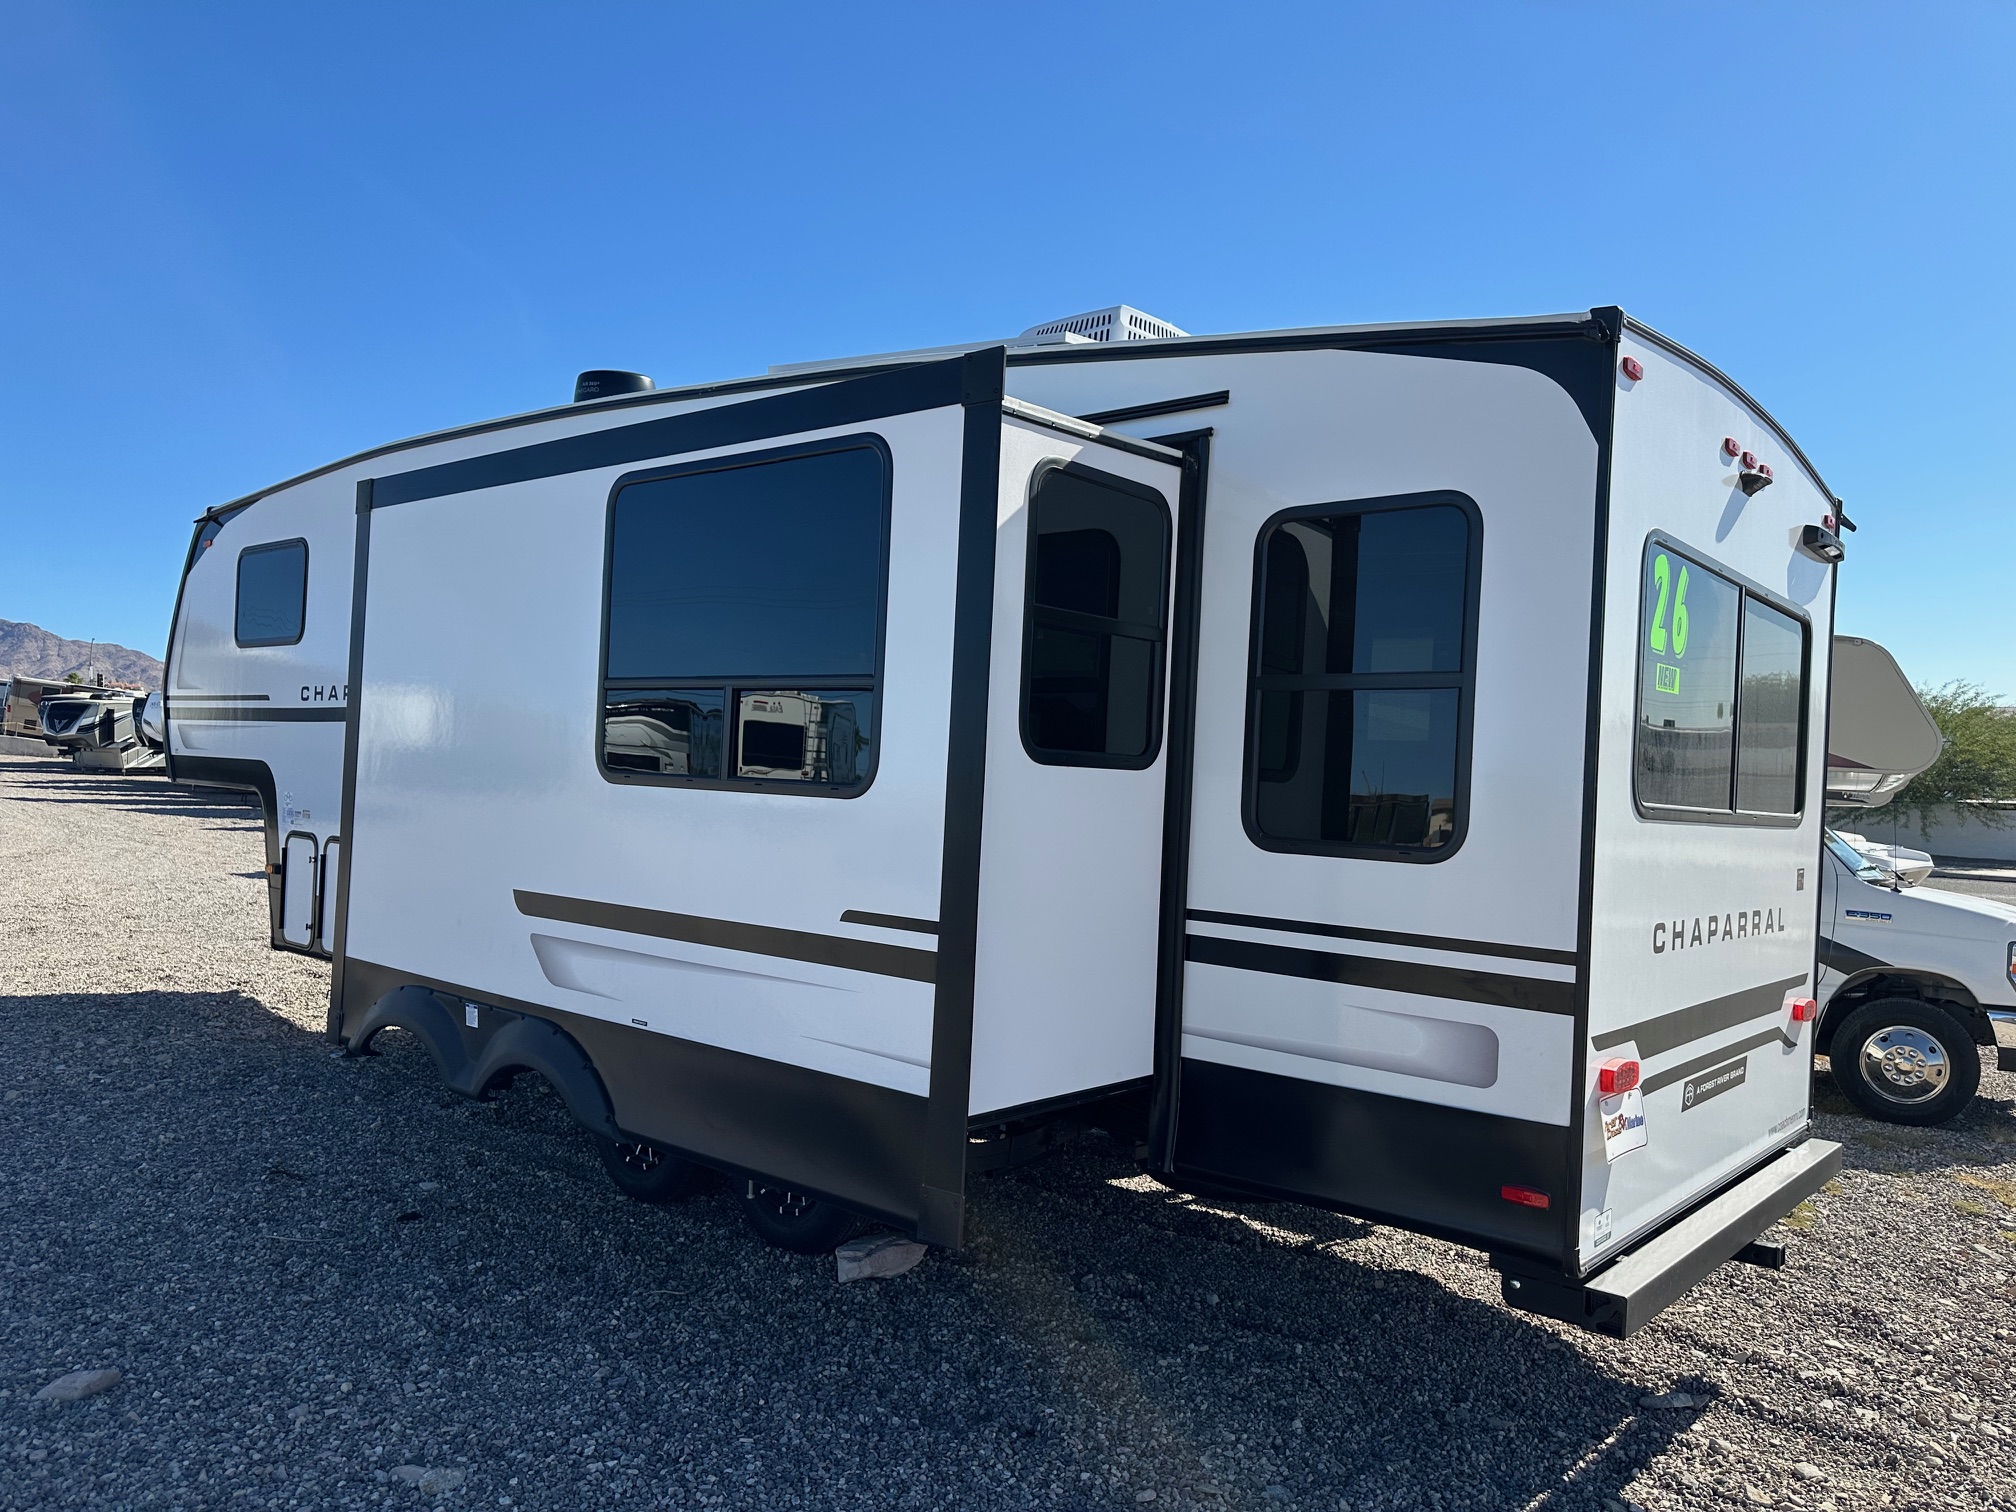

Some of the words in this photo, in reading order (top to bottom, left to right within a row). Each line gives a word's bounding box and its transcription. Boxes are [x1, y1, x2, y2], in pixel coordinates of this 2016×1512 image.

[1650, 553, 1690, 660] 26
[1657, 665, 1678, 688] NEW
[1653, 907, 1785, 955] CHAPARRAL
[1696, 1086, 1700, 1095] A
[1700, 1078, 1717, 1093] FOREST
[1716, 1073, 1730, 1086] RIVER
[1730, 1066, 1744, 1079] BRAND
